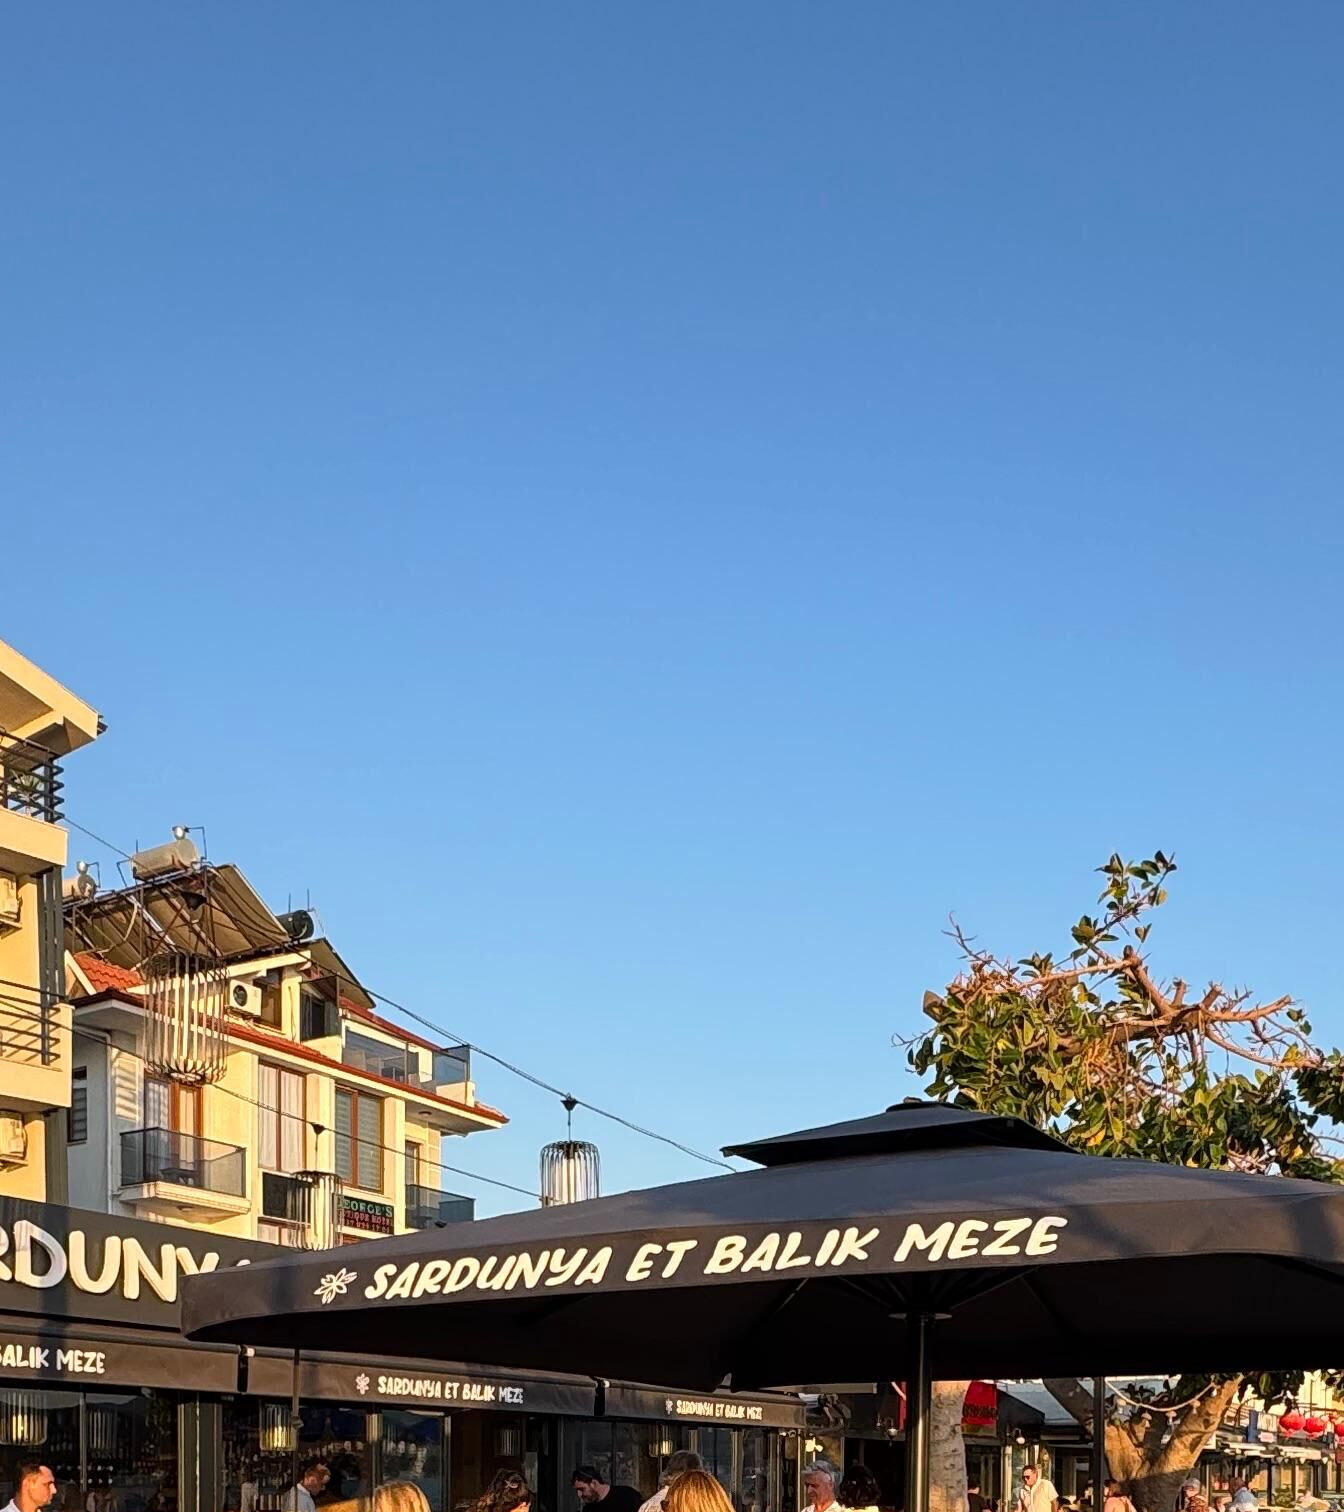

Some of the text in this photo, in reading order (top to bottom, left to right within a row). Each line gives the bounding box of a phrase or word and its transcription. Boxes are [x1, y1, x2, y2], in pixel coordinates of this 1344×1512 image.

[364, 1216, 1068, 1301] SARDUNYA ET BALIK MEZE
[56, 1348, 106, 1374] MEZE
[377, 1375, 442, 1399] SARDUNYA
[444, 1381, 460, 1400] ET
[462, 1383, 496, 1402] BALIK
